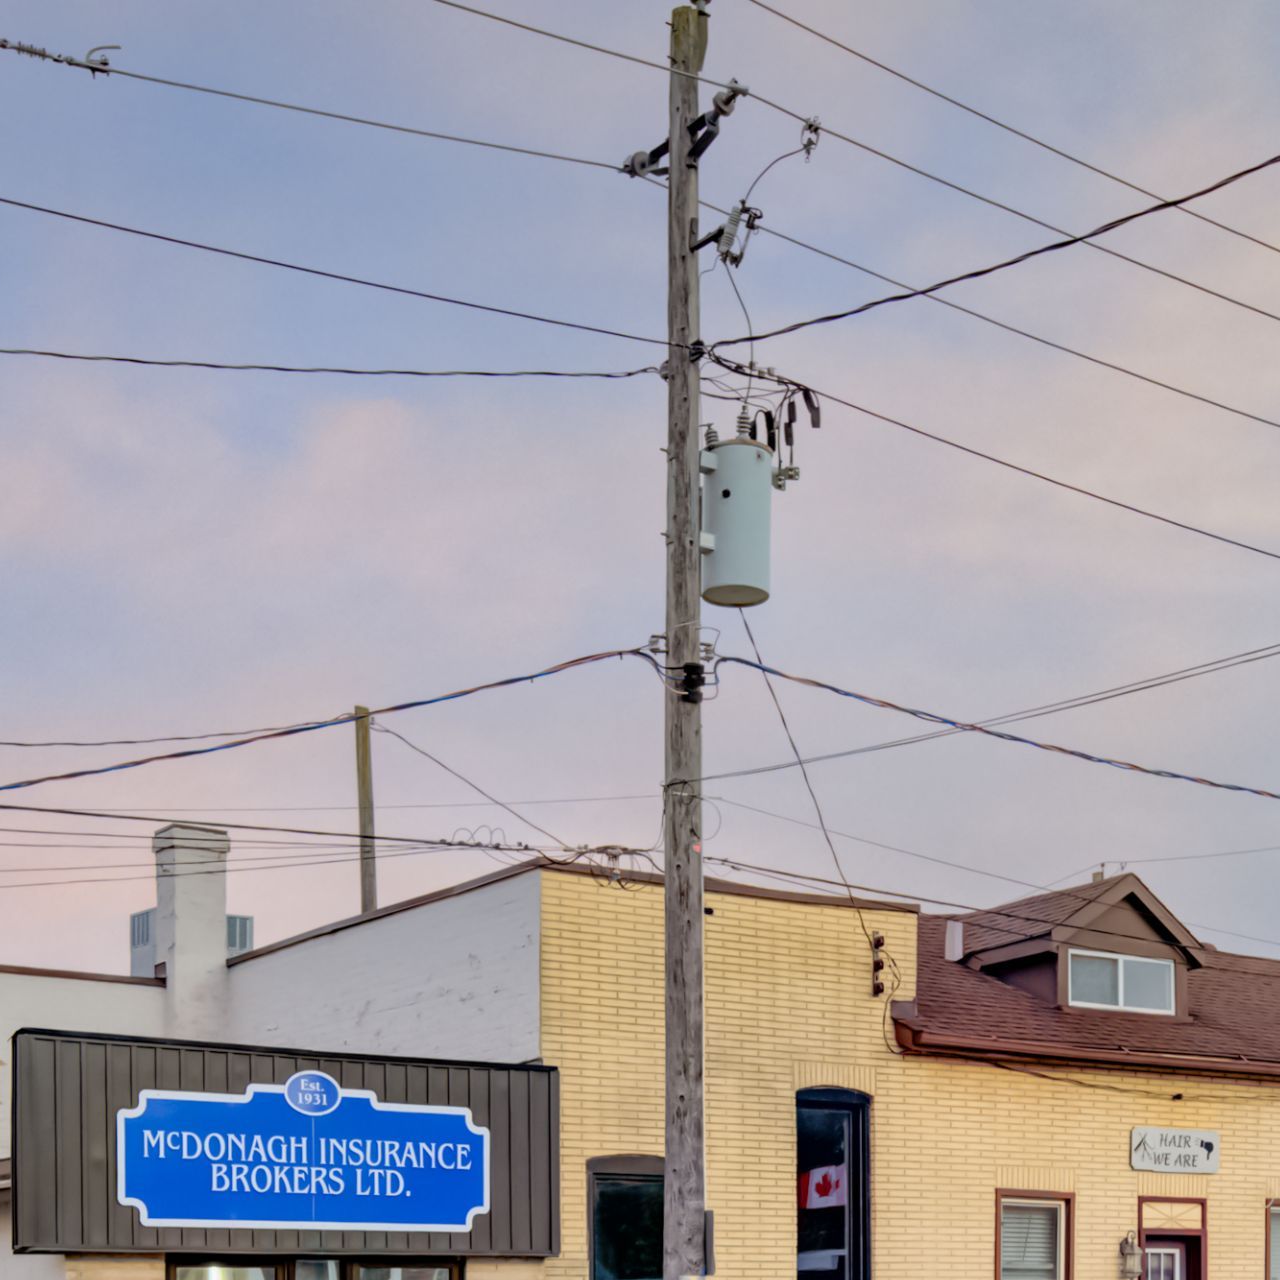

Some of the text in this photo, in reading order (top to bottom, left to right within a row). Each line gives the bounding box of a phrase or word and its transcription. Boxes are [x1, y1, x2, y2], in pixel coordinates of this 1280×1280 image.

[299, 1078, 325, 1093] Est.
[296, 1092, 329, 1107] 1931
[1159, 1133, 1192, 1149] HAIR
[319, 1137, 473, 1171] INSURANCE
[1153, 1151, 1199, 1168] WE ARE
[210, 1164, 412, 1197] BROKERS LTD.
